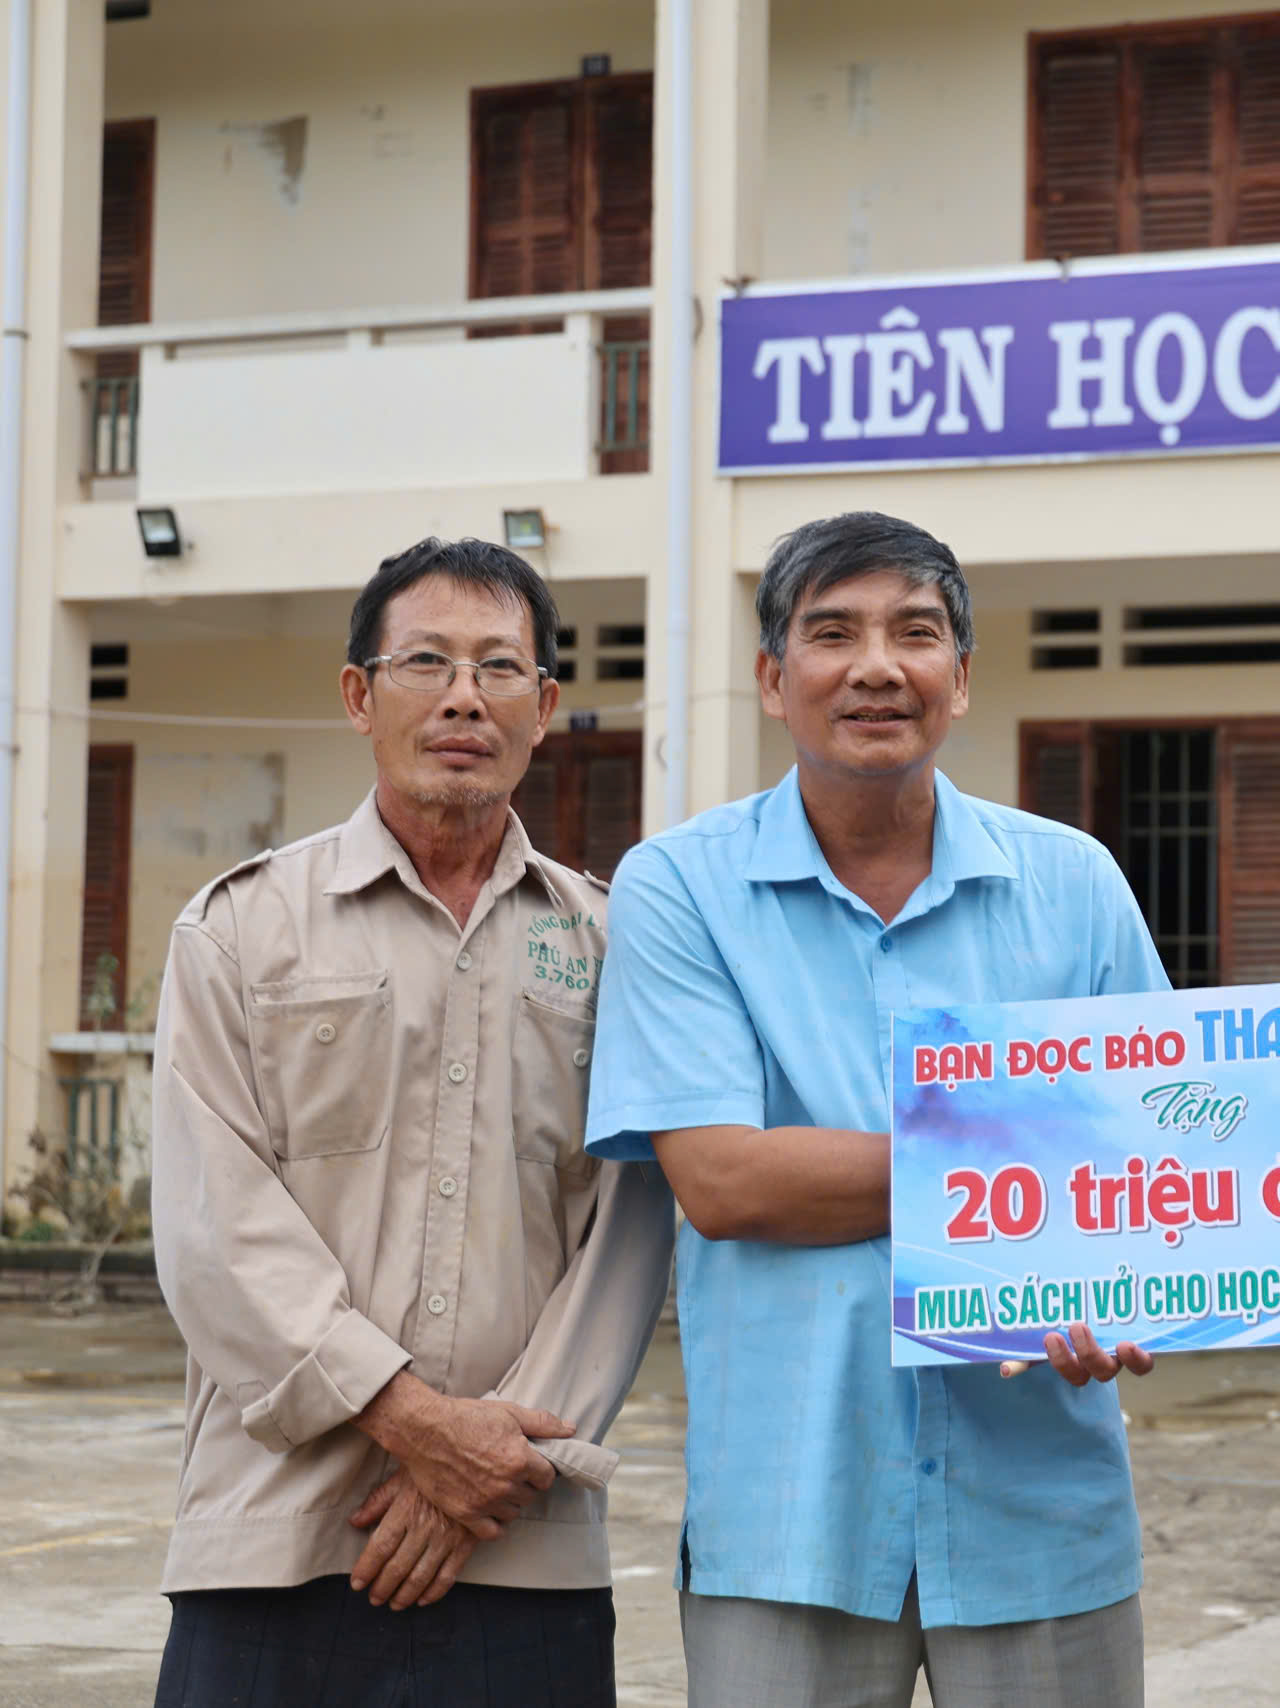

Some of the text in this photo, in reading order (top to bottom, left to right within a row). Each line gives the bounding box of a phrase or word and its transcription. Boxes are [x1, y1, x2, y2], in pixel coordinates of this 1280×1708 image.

[753, 305, 1014, 443] TIÊN
[915, 1043, 993, 1090] BẠN
[1006, 1036, 1092, 1084] ĐỌC
[1104, 1025, 1186, 1070] BÁO
[1141, 1081, 1243, 1138] Tặng
[946, 1166, 1043, 1239] 20
[1070, 1157, 1236, 1244] triệu
[918, 1288, 988, 1330] MUA
[998, 1275, 1083, 1326] SÁCH
[1092, 1265, 1134, 1320] VỞ
[1143, 1273, 1206, 1316] CHO
[1217, 1268, 1280, 1319] HỌC
